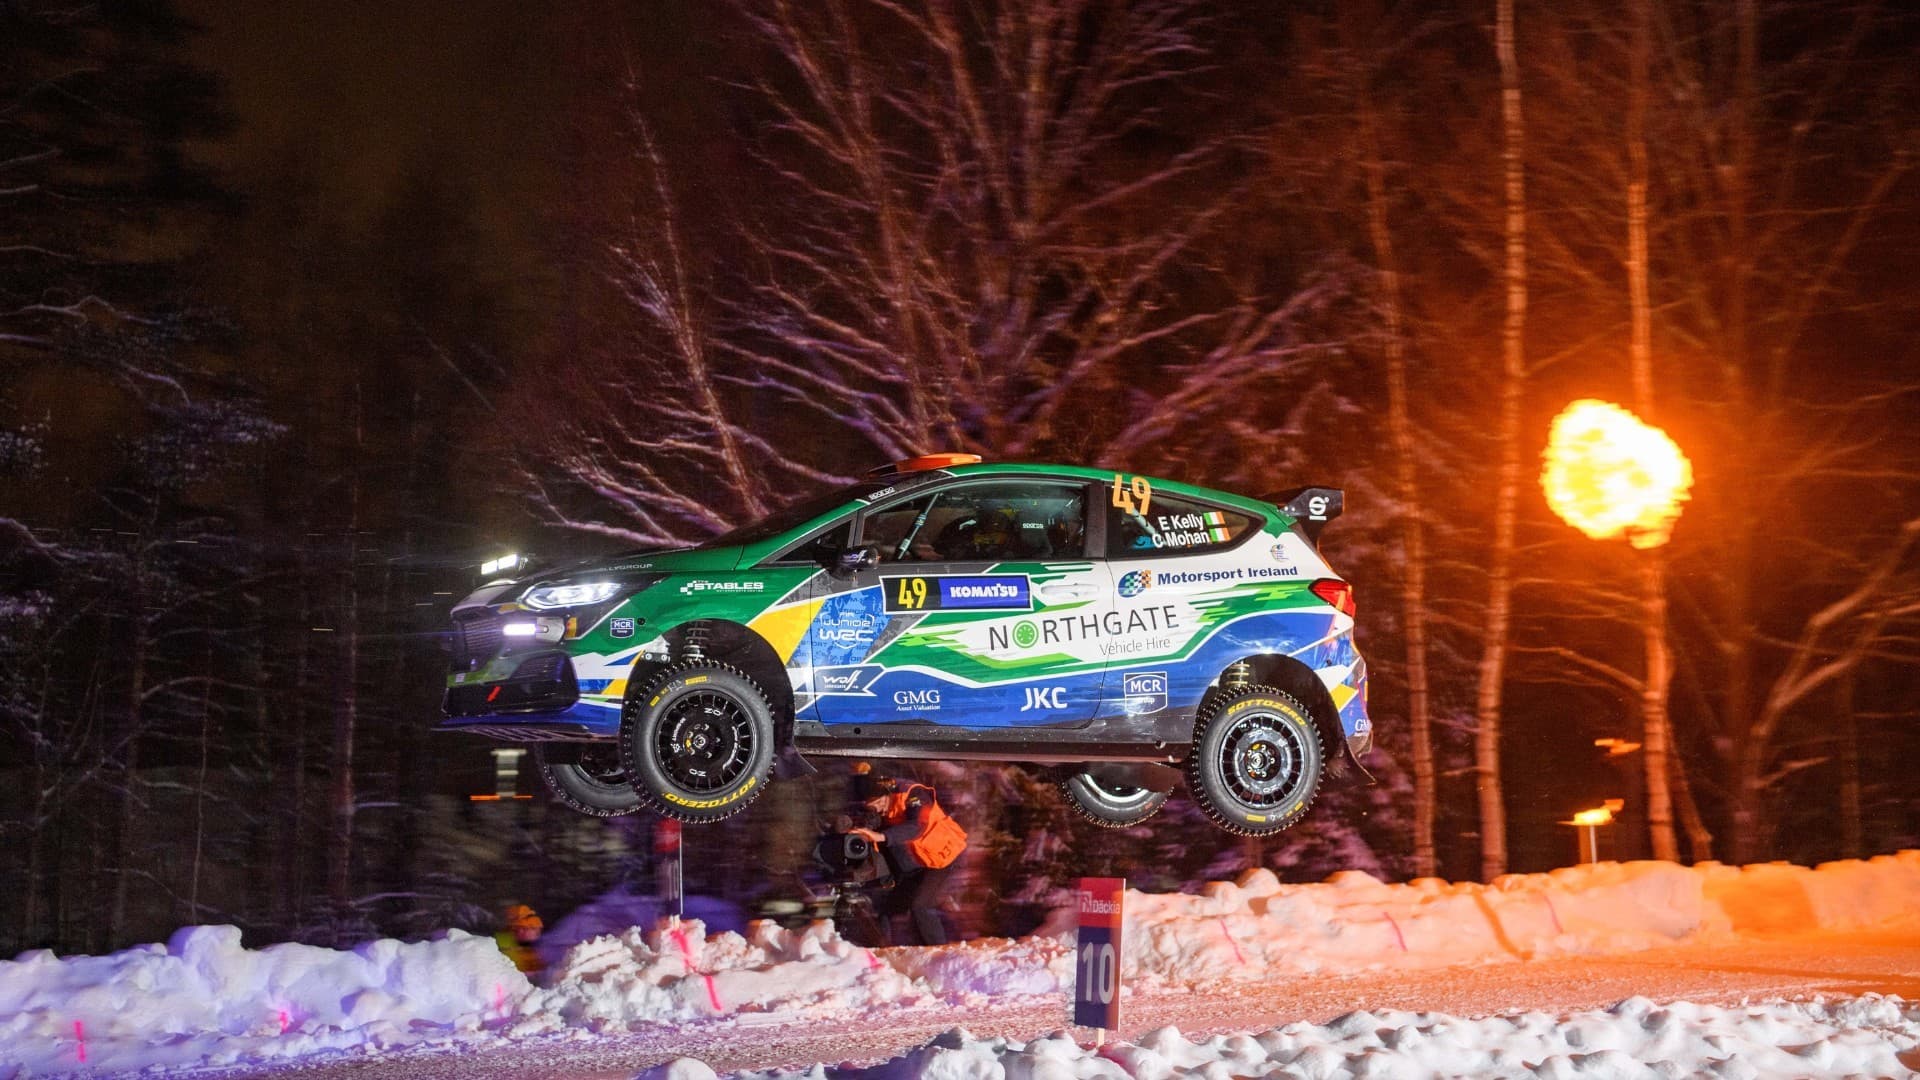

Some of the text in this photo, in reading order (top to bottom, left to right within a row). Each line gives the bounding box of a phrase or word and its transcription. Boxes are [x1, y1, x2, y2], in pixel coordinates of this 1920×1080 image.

[1112, 474, 1151, 516] 49
[1158, 513, 1205, 531] E Kelly
[1152, 529, 1211, 548] C Mohan
[1157, 566, 1298, 585] Motorsport Ireland
[694, 582, 764, 590] STABLES
[898, 578, 927, 609] 49
[950, 583, 1018, 598] KOMATSU
[1100, 636, 1171, 656] Vehicle Hire
[1130, 679, 1162, 693] MCR
[893, 689, 940, 704] GMG
[1020, 686, 1068, 712] JKC
[1227, 698, 1306, 727] SOTTOZERO
[664, 776, 757, 809] SOTTOZERO
[1093, 899, 1121, 914] Däckia
[1083, 941, 1116, 1004] 10
